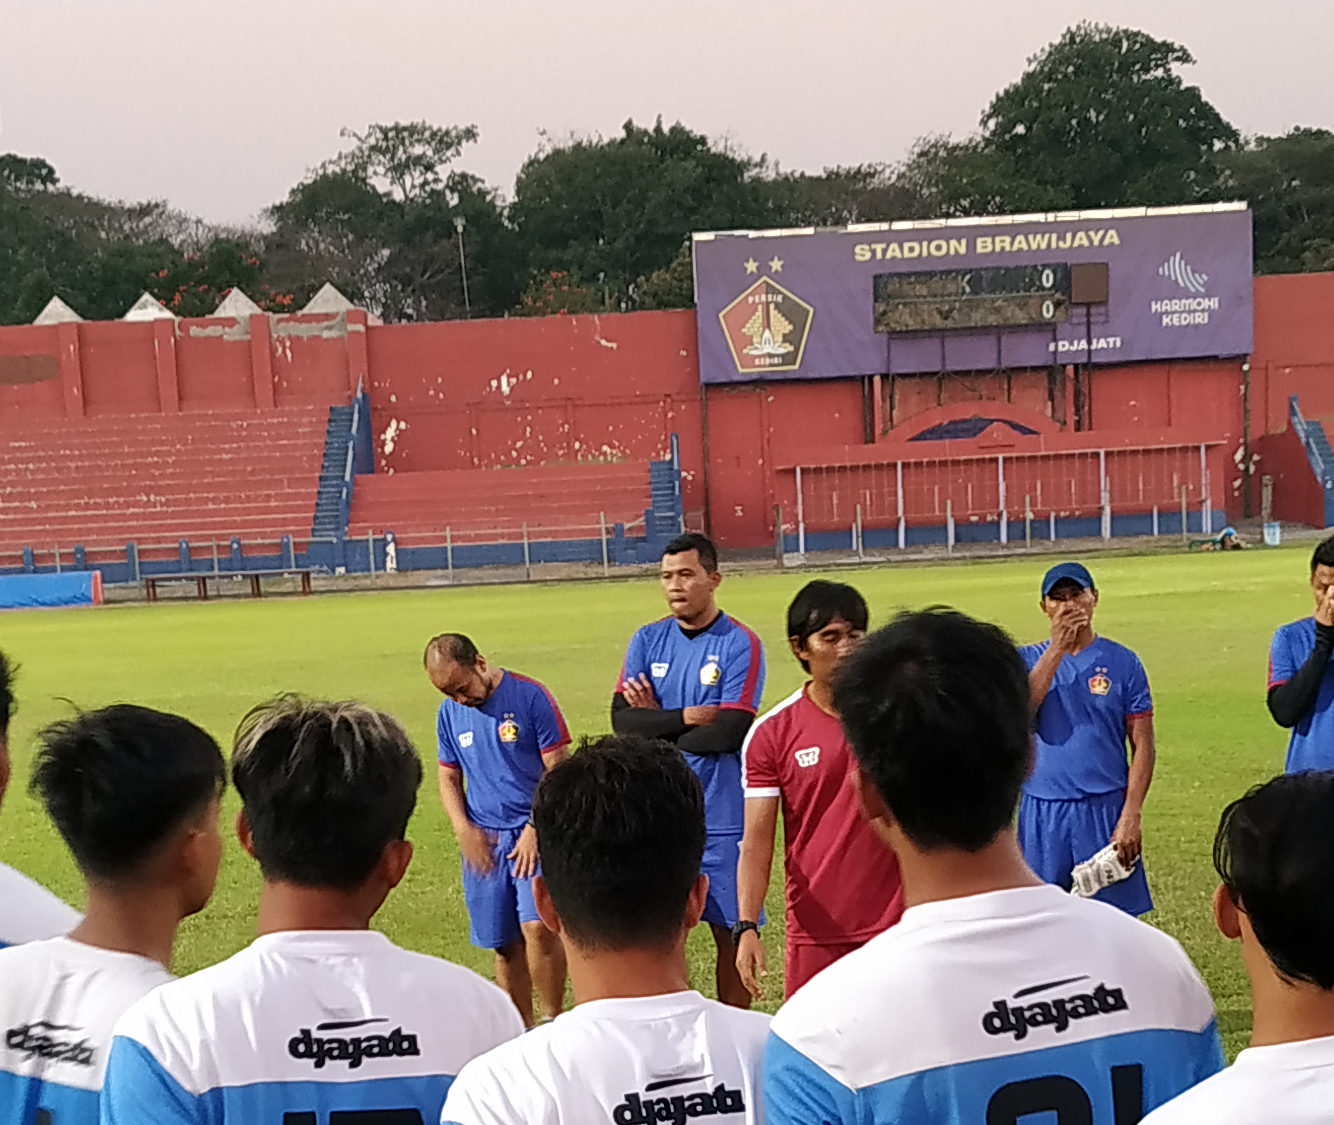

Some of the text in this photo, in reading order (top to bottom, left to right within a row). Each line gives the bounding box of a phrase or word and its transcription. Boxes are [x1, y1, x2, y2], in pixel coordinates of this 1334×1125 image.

[853, 229, 1121, 262] STADION BRAWIJAYA
[1041, 268, 1054, 288] 0
[748, 293, 784, 305] PERSIK
[1042, 300, 1055, 319] 0
[1162, 311, 1209, 327] KEDIRI
[982, 982, 1130, 1041] djajati
[287, 1026, 421, 1069] djajati
